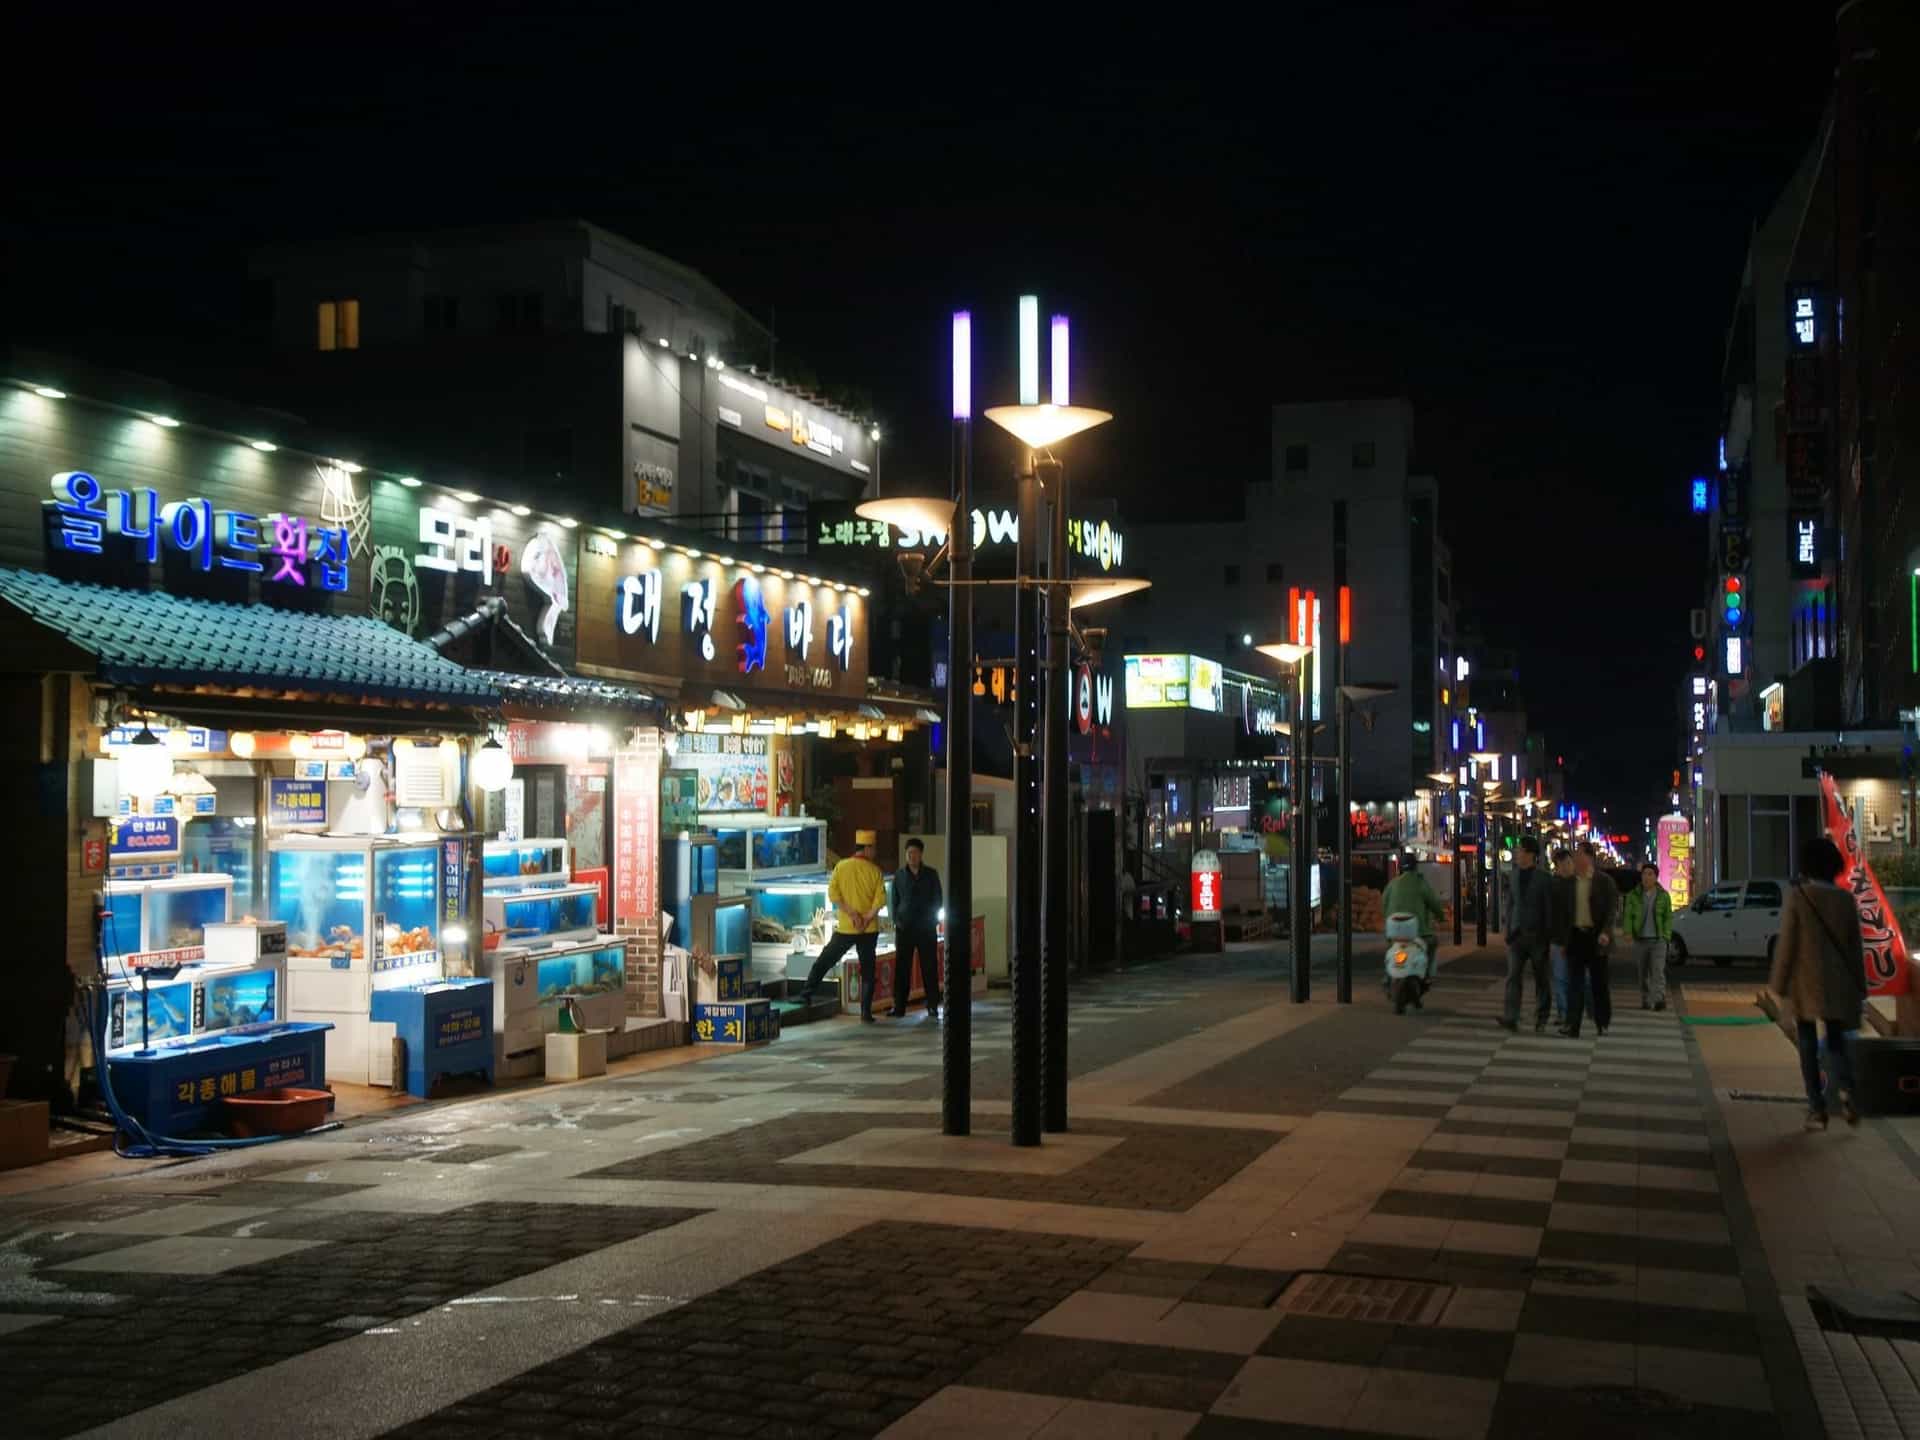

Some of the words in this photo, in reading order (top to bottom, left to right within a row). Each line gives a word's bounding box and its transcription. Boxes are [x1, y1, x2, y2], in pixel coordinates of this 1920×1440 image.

[818, 520, 890, 548] 노래주점
[897, 508, 1018, 550] SOW
[1083, 520, 1123, 572] SHOW
[177, 1068, 257, 1105] 각종해물
